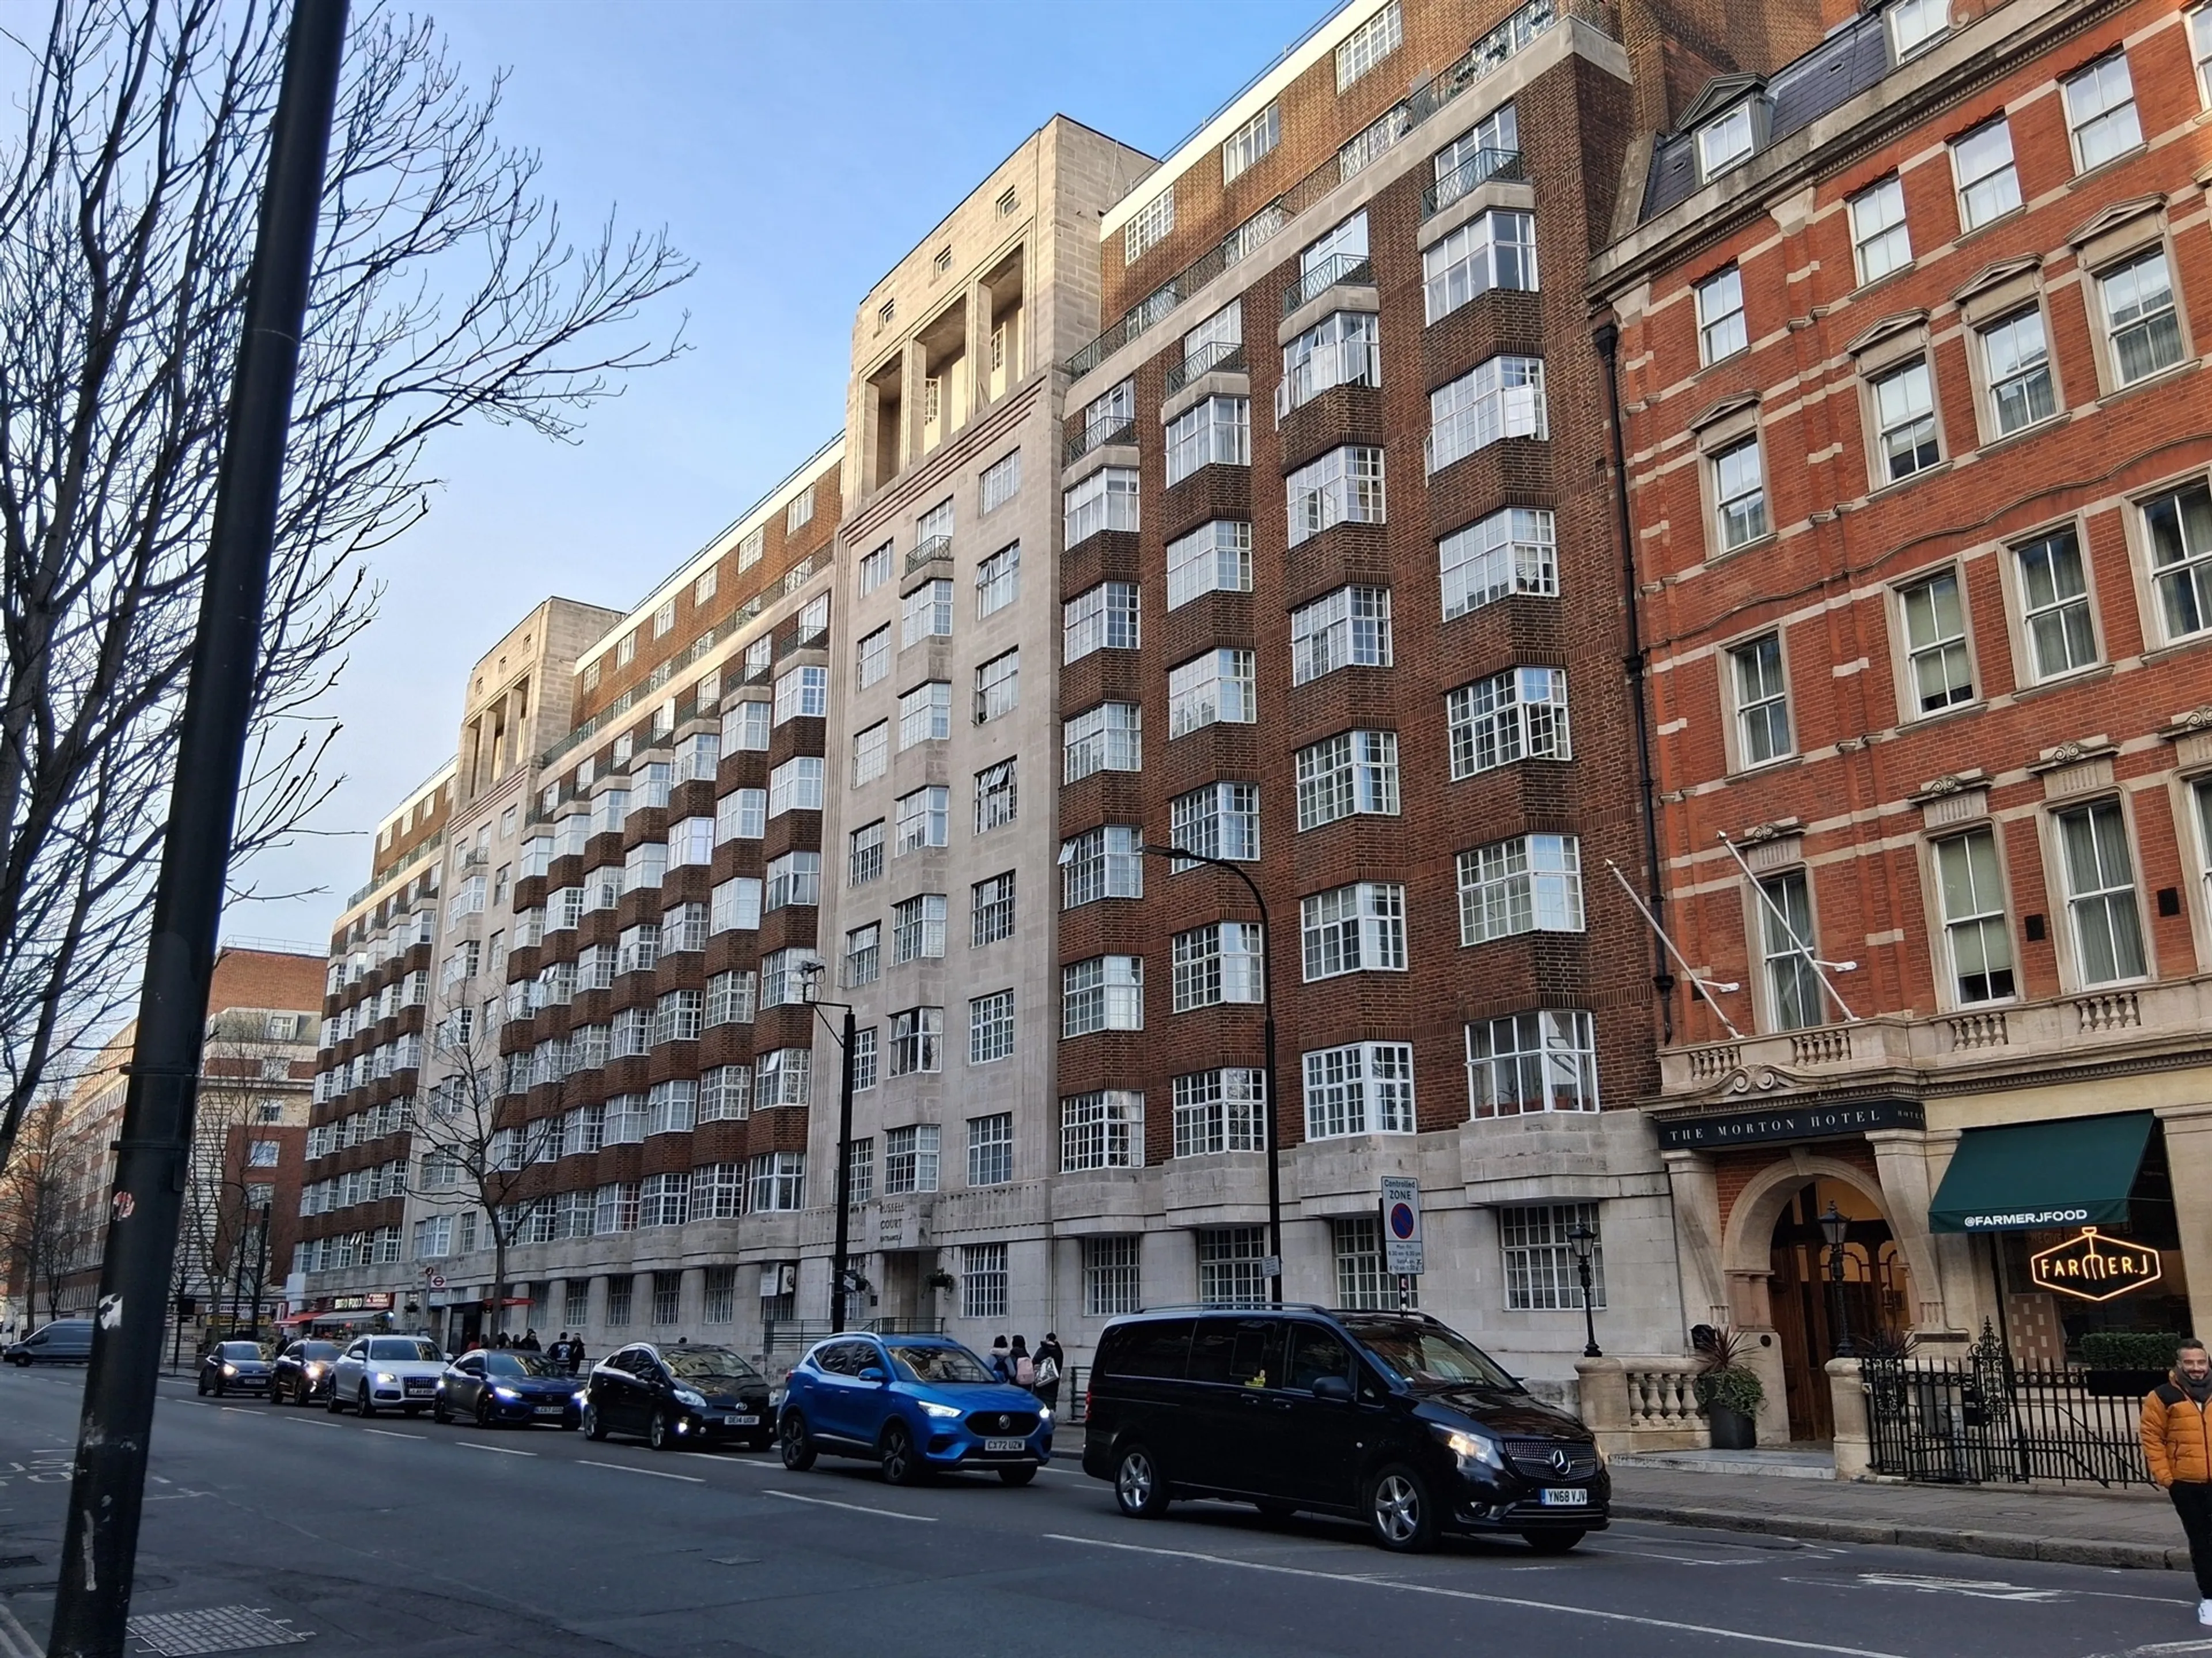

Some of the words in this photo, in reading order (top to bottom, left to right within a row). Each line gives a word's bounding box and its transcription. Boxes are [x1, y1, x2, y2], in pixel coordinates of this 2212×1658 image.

[1671, 1127, 1703, 1141] THE
[1717, 1118, 1795, 1137] MORTON
[1811, 1110, 1880, 1127] HOTEL
[1384, 1179, 1415, 1188] Controlled
[1389, 1190, 1412, 1199] ZONE
[880, 1218, 903, 1230] COURT
[1964, 1209, 2088, 1227] @FARMERJFOOD
[988, 1441, 1007, 1449] CX72
[1548, 1490, 1570, 1502] YN68
